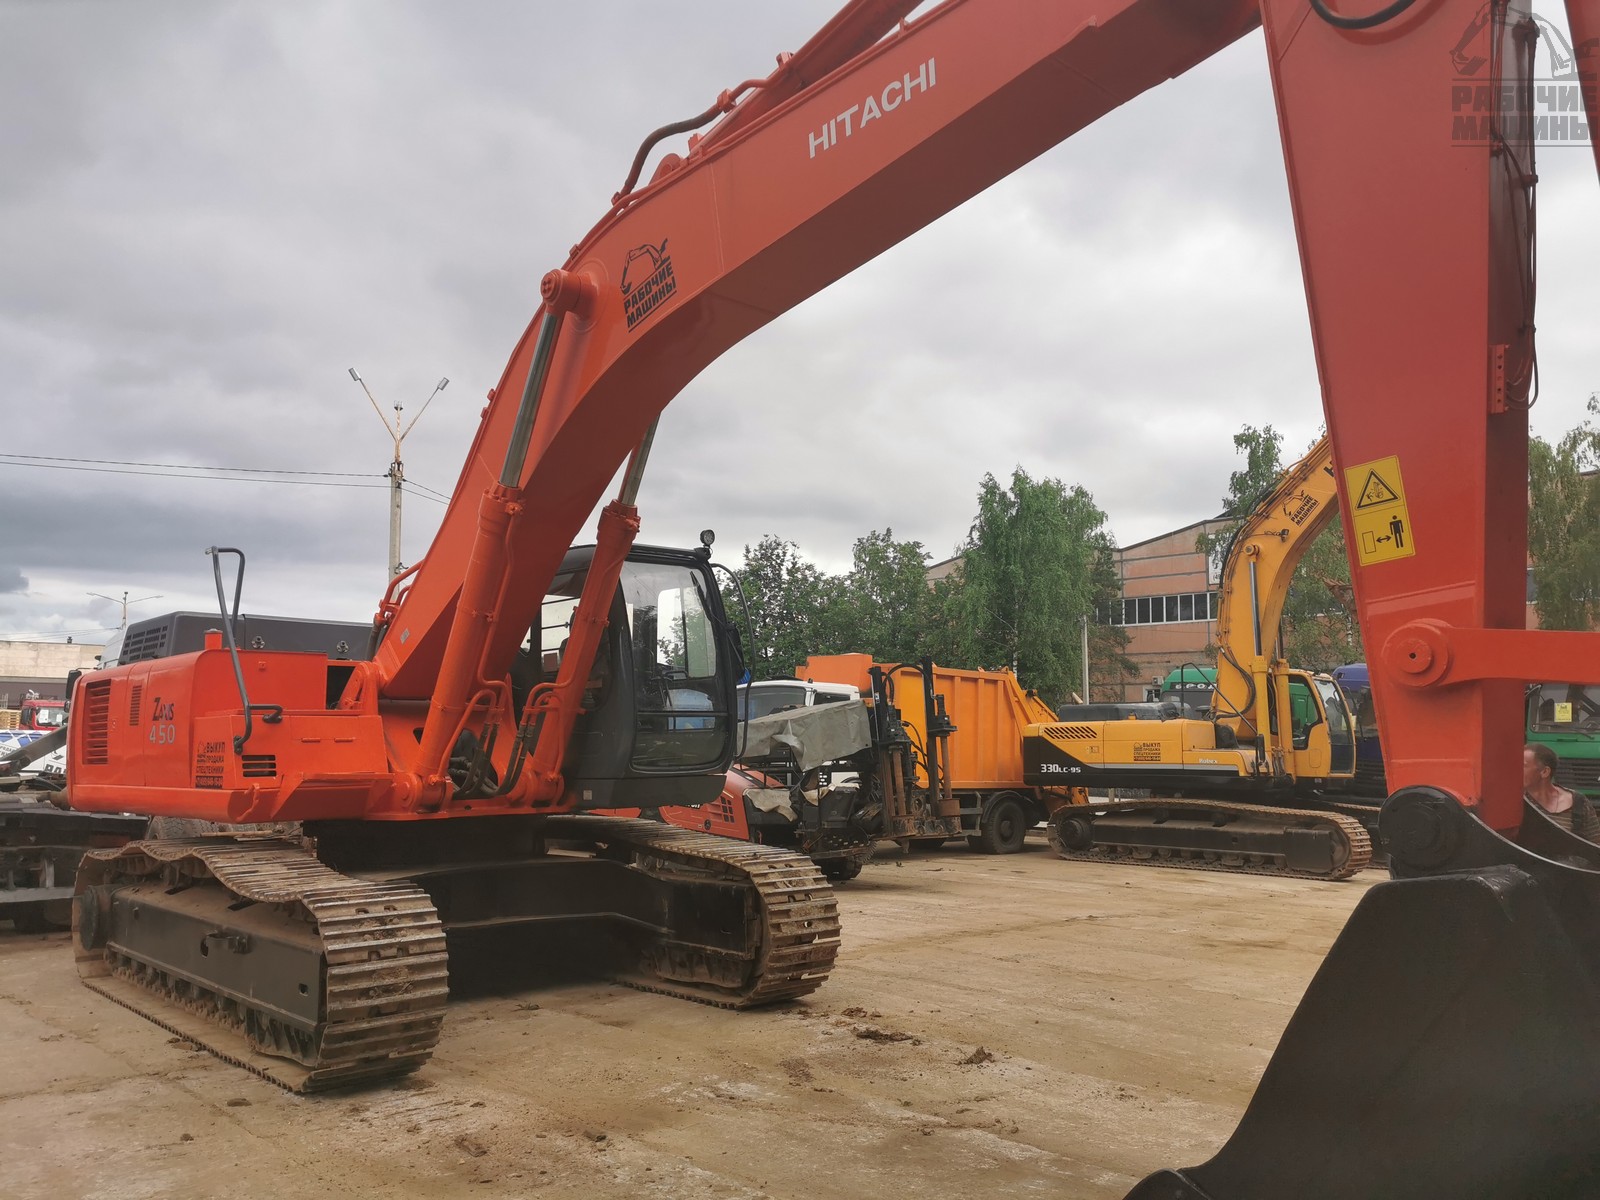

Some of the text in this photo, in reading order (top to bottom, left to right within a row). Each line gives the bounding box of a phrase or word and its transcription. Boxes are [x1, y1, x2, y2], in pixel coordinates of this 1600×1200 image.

[808, 57, 936, 159] HITACHI
[623, 261, 674, 314] РАБОЧИЕ
[626, 275, 677, 328] МАШИНЫ
[1290, 495, 1313, 522] РАБОЧИЕ
[1295, 499, 1319, 526] МАШИНЫ
[149, 723, 176, 745] 450
